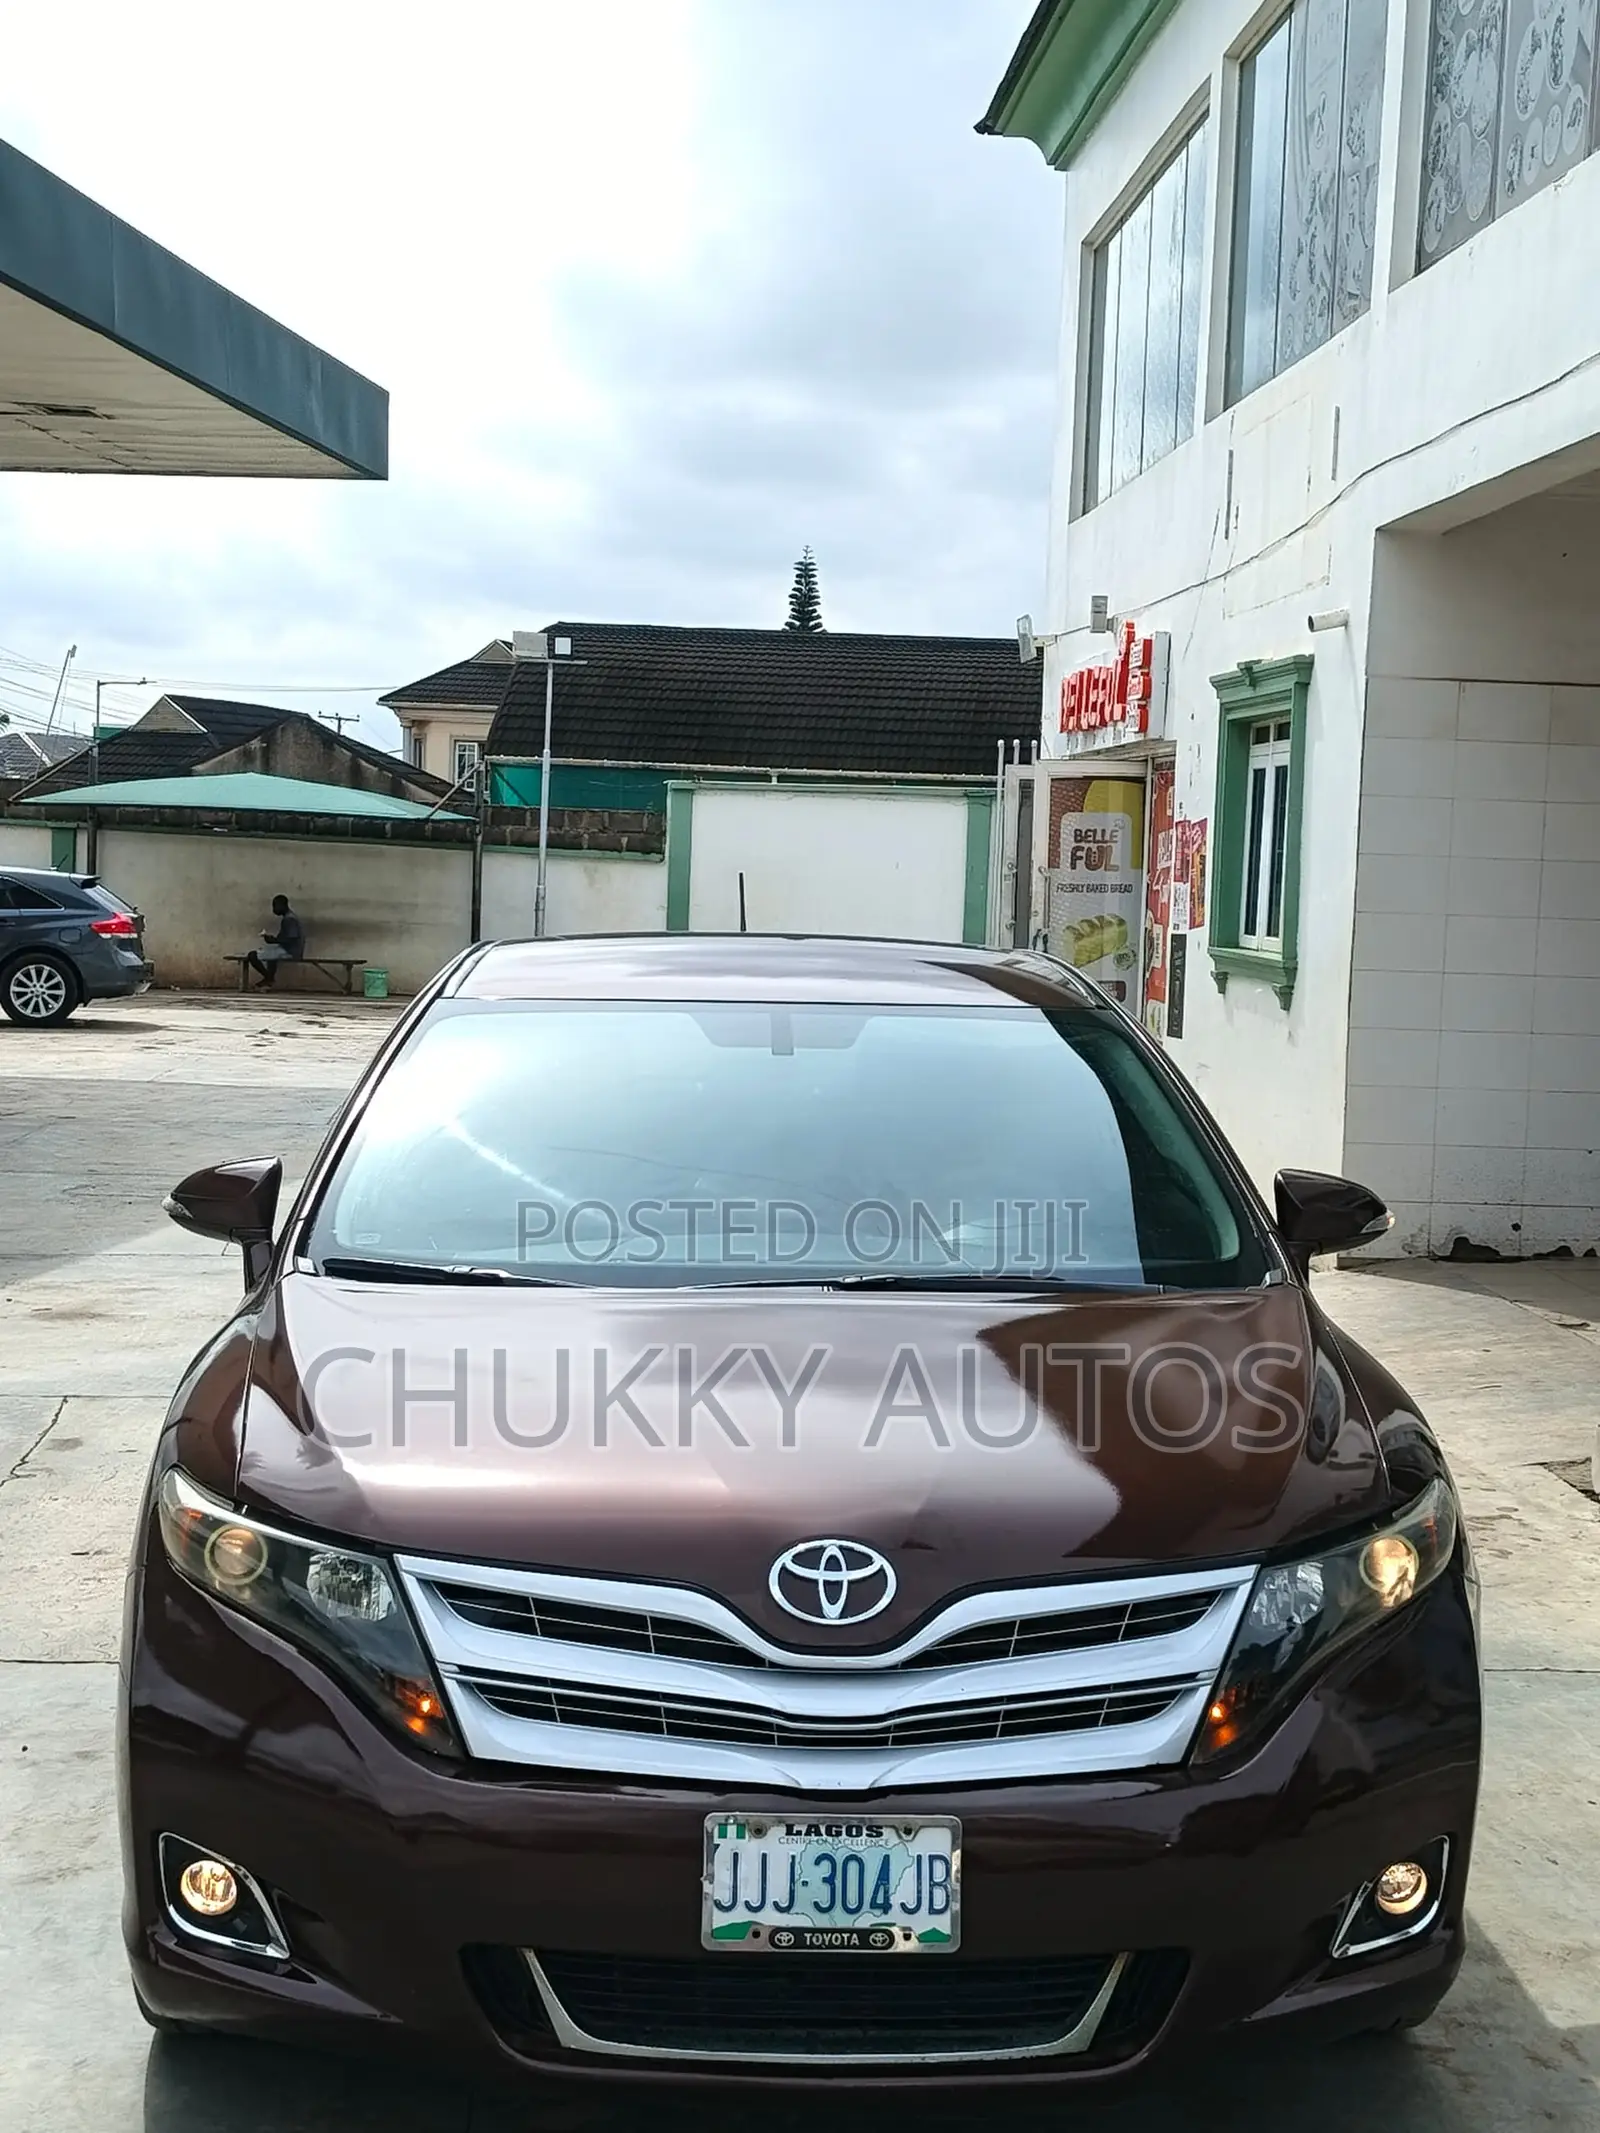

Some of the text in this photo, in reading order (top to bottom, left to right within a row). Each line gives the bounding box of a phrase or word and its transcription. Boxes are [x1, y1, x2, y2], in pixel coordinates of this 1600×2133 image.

[1073, 828, 1119, 844] BELLE
[1070, 845, 1119, 872] FUL
[1056, 883, 1133, 893] FRESHLY BAKED BREAD
[785, 1823, 884, 1839] LAGOS
[831, 1838, 890, 1847] EXCELLENCE
[803, 1933, 860, 1946] TOYOTA
